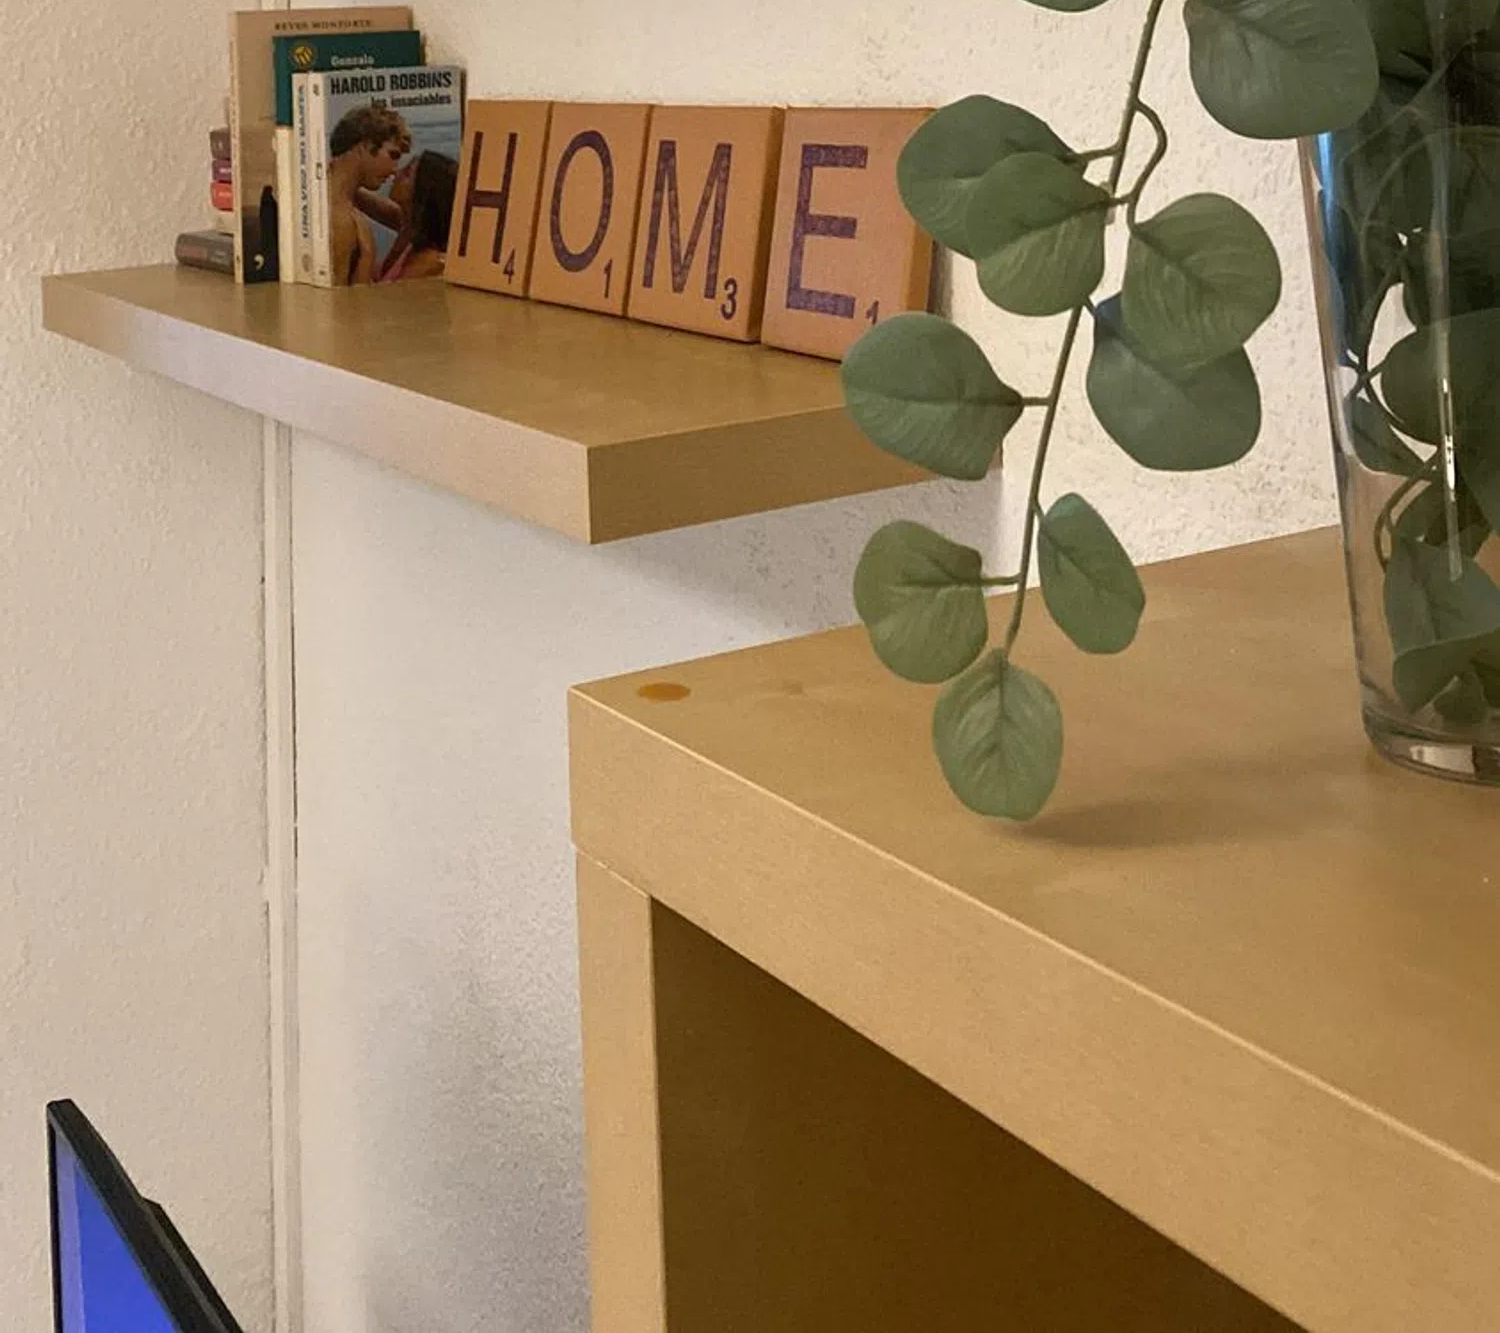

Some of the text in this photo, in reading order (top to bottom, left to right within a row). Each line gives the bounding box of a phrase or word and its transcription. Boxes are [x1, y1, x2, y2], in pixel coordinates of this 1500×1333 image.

[330, 54, 374, 66] Gonzalo
[330, 75, 386, 95] HAROLD
[391, 71, 452, 90] ROBBINS
[371, 93, 451, 108] los insaciables
[457, 129, 868, 319] HOME
[502, 249, 515, 285] 4
[603, 259, 613, 299] 1
[720, 278, 738, 320] 3
